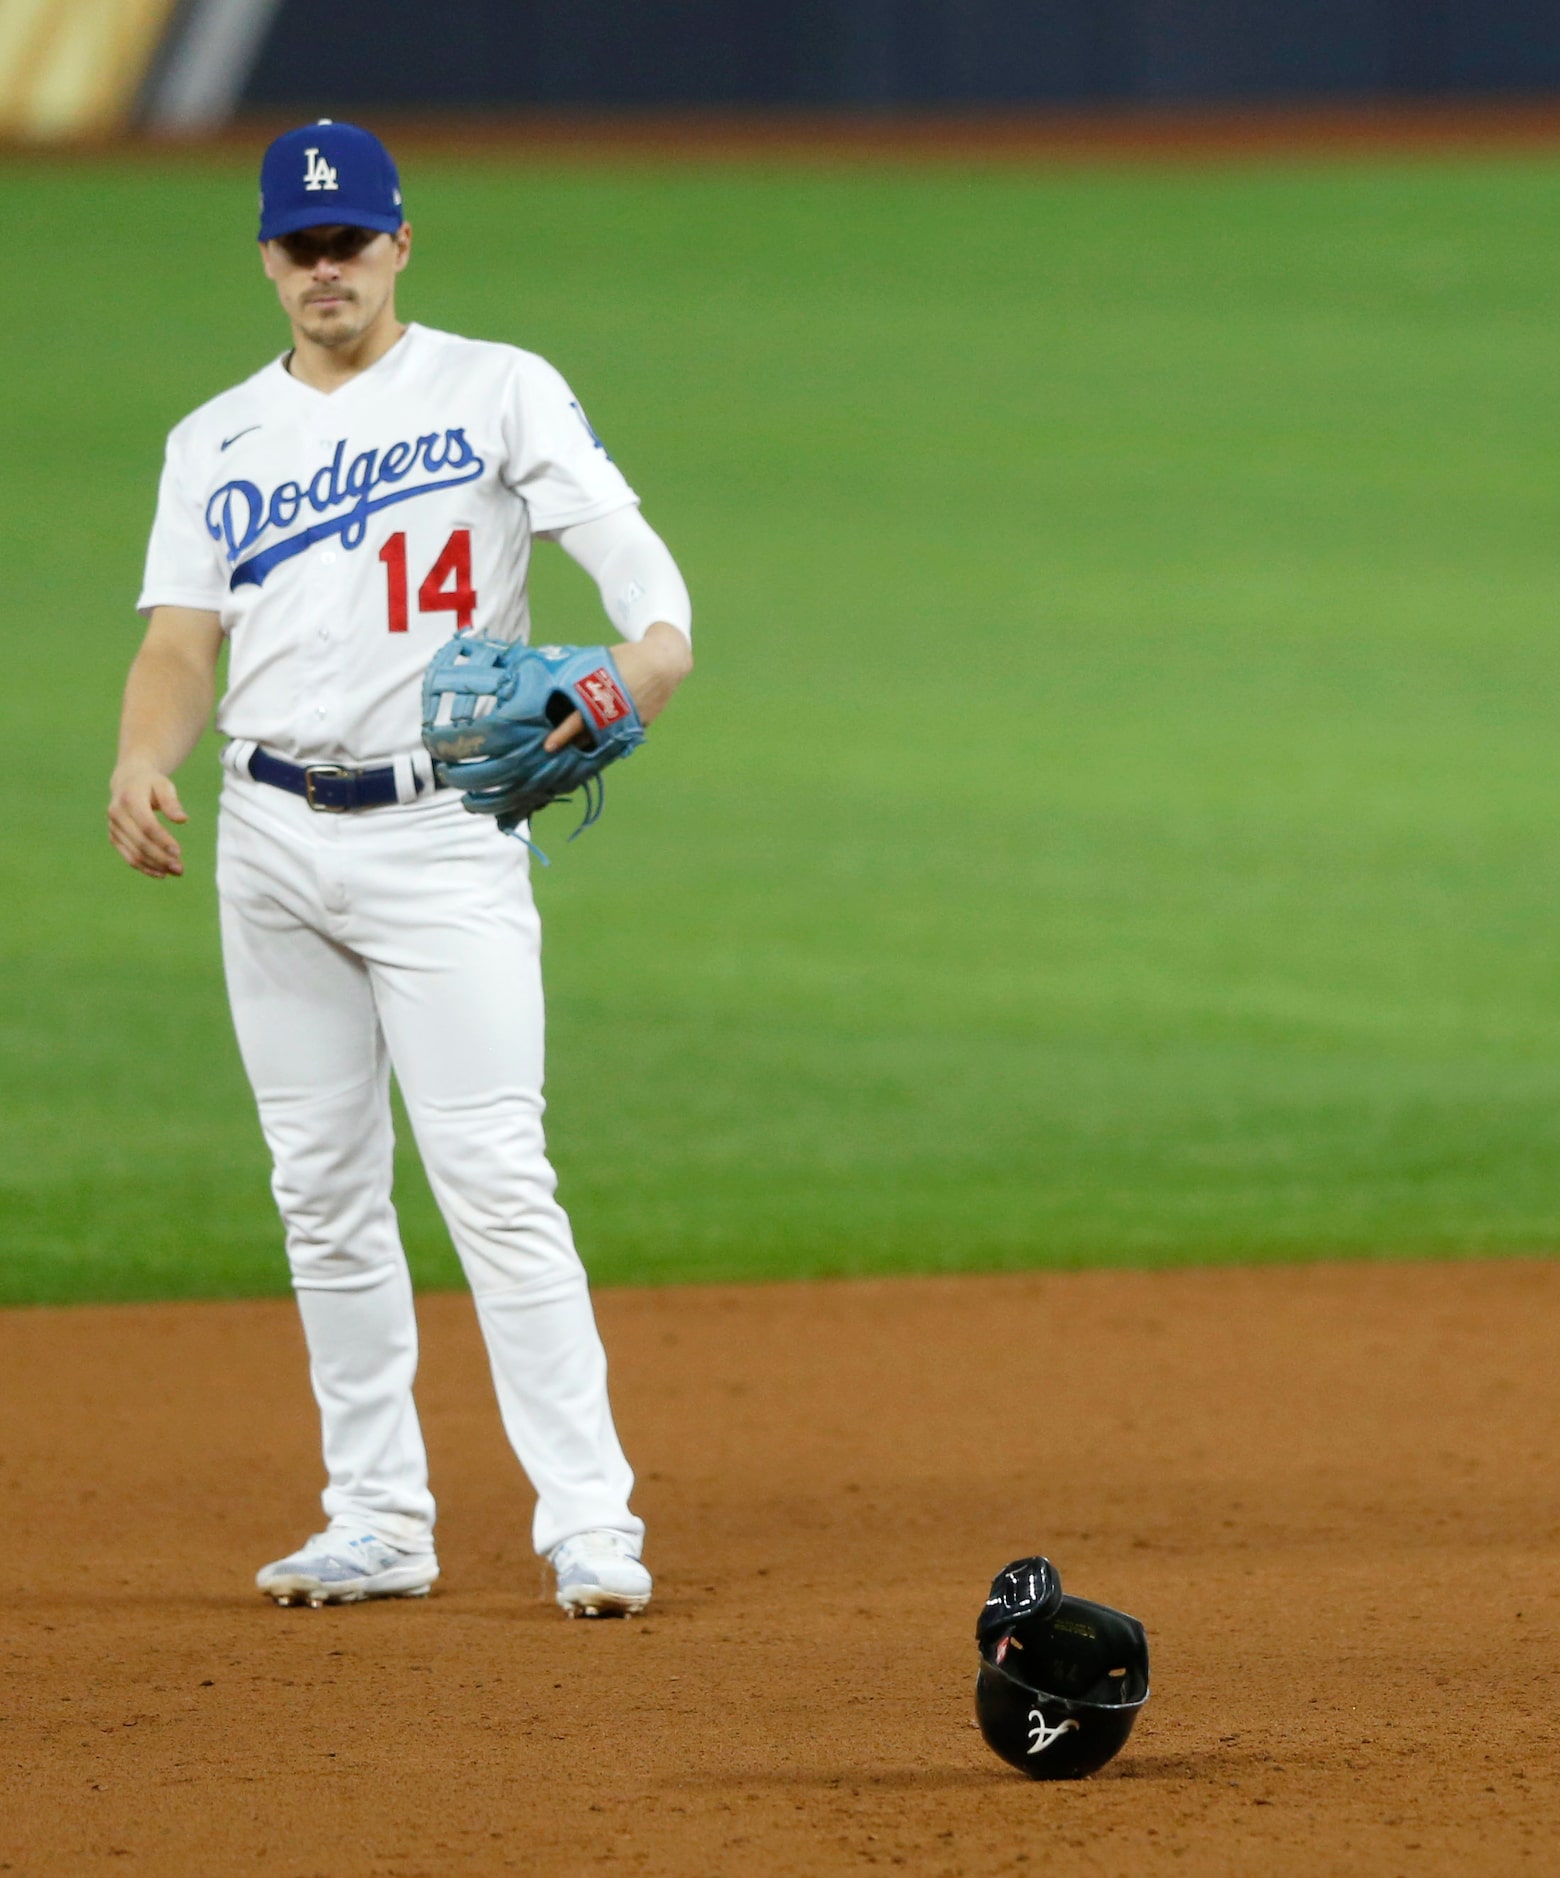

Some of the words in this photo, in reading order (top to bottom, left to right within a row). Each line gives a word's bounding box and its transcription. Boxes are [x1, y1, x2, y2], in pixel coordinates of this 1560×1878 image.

[303, 147, 339, 191] LA
[205, 427, 485, 561] Dodgers
[379, 529, 477, 634] 14
[1026, 1709, 1080, 1755] A
